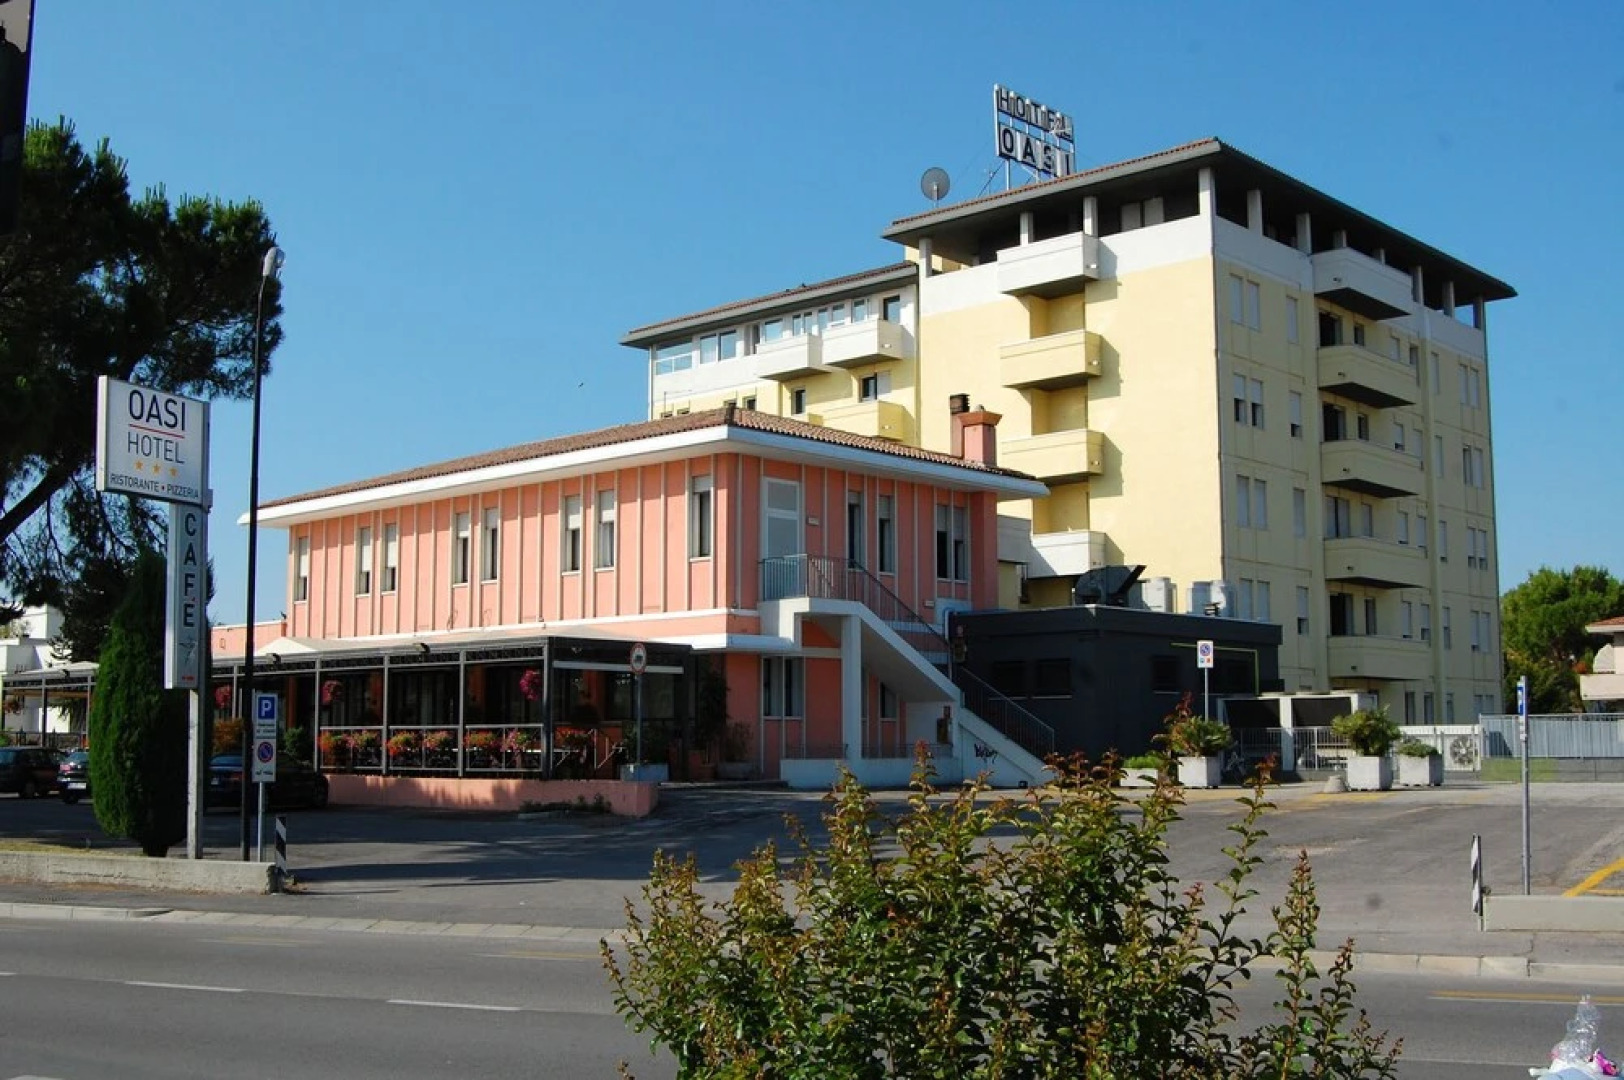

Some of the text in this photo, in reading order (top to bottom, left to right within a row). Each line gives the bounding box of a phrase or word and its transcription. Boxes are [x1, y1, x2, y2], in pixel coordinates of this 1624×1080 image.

[997, 87, 1072, 139] HOTEL
[1002, 128, 1070, 176] OASI
[129, 389, 186, 431] OASI
[127, 431, 185, 464] HOTEL
[110, 473, 199, 498] RISTORANTE PIZZERIA
[261, 700, 272, 717] P
